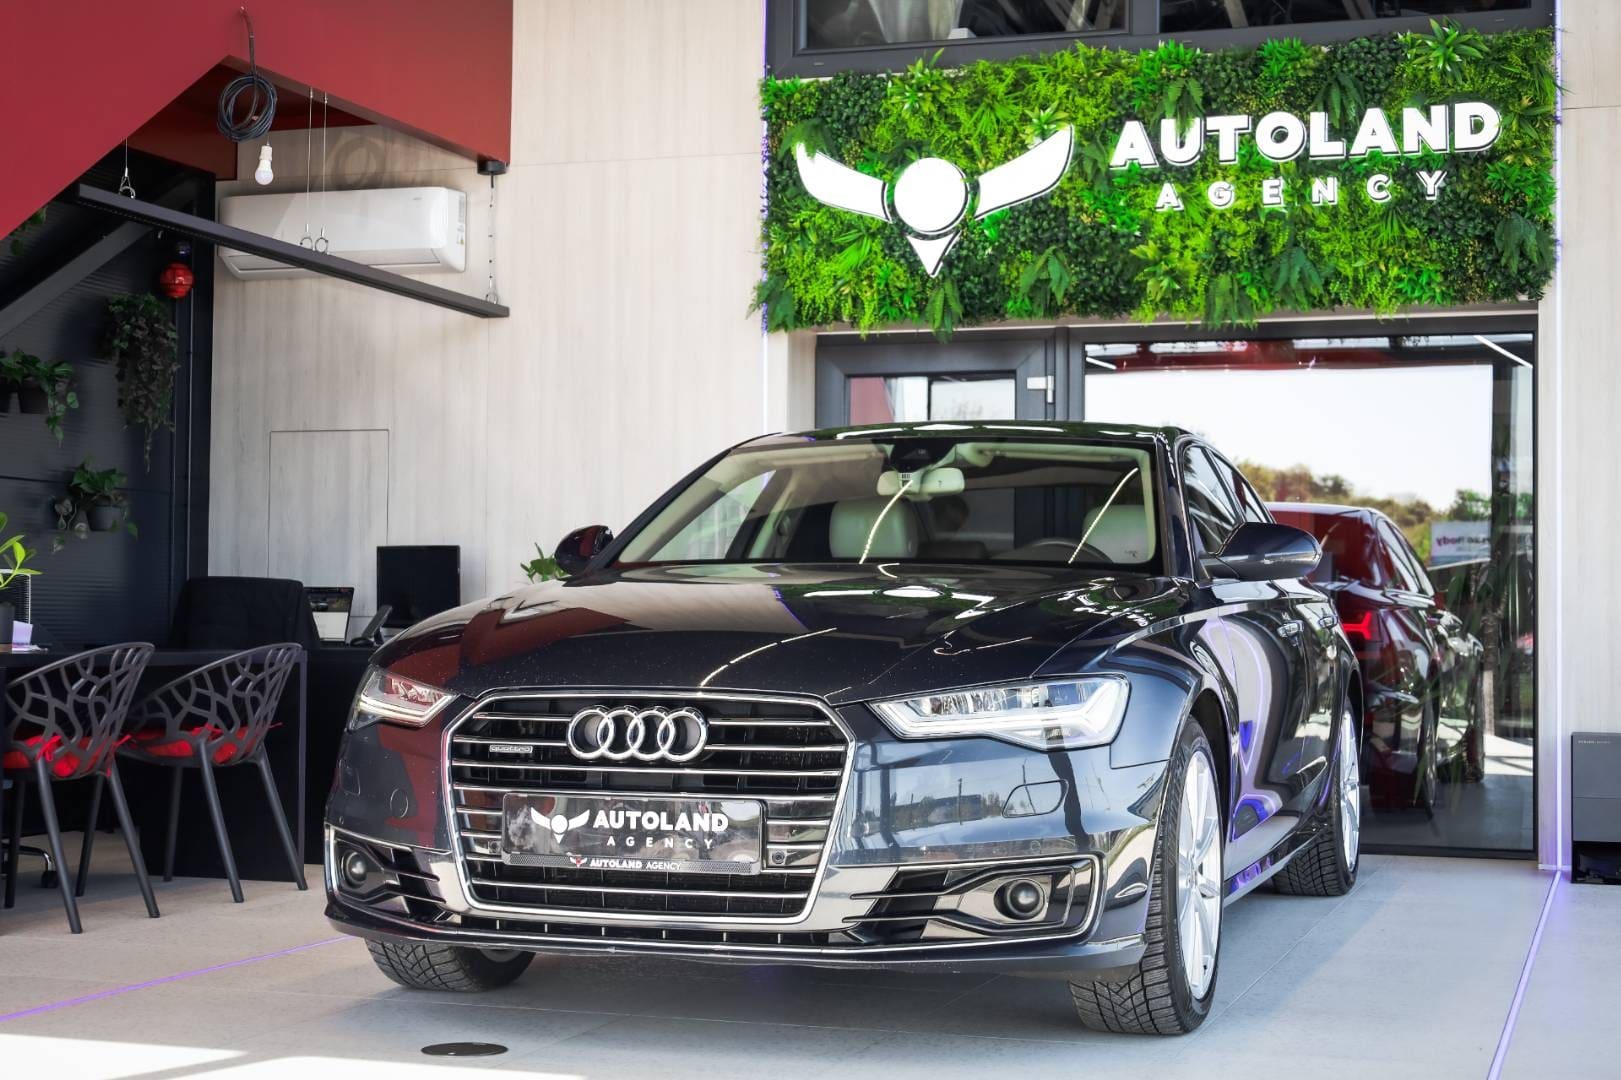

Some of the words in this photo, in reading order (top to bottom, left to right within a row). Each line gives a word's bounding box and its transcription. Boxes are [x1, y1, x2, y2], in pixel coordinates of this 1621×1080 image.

[1109, 101, 1502, 170] AUTOLAND
[1155, 169, 1446, 212] AGENCY
[593, 809, 729, 832] AUTOLAND
[606, 835, 713, 850] AGENCY
[590, 857, 643, 869] AUTOLAND
[645, 860, 681, 871] AGENCY
